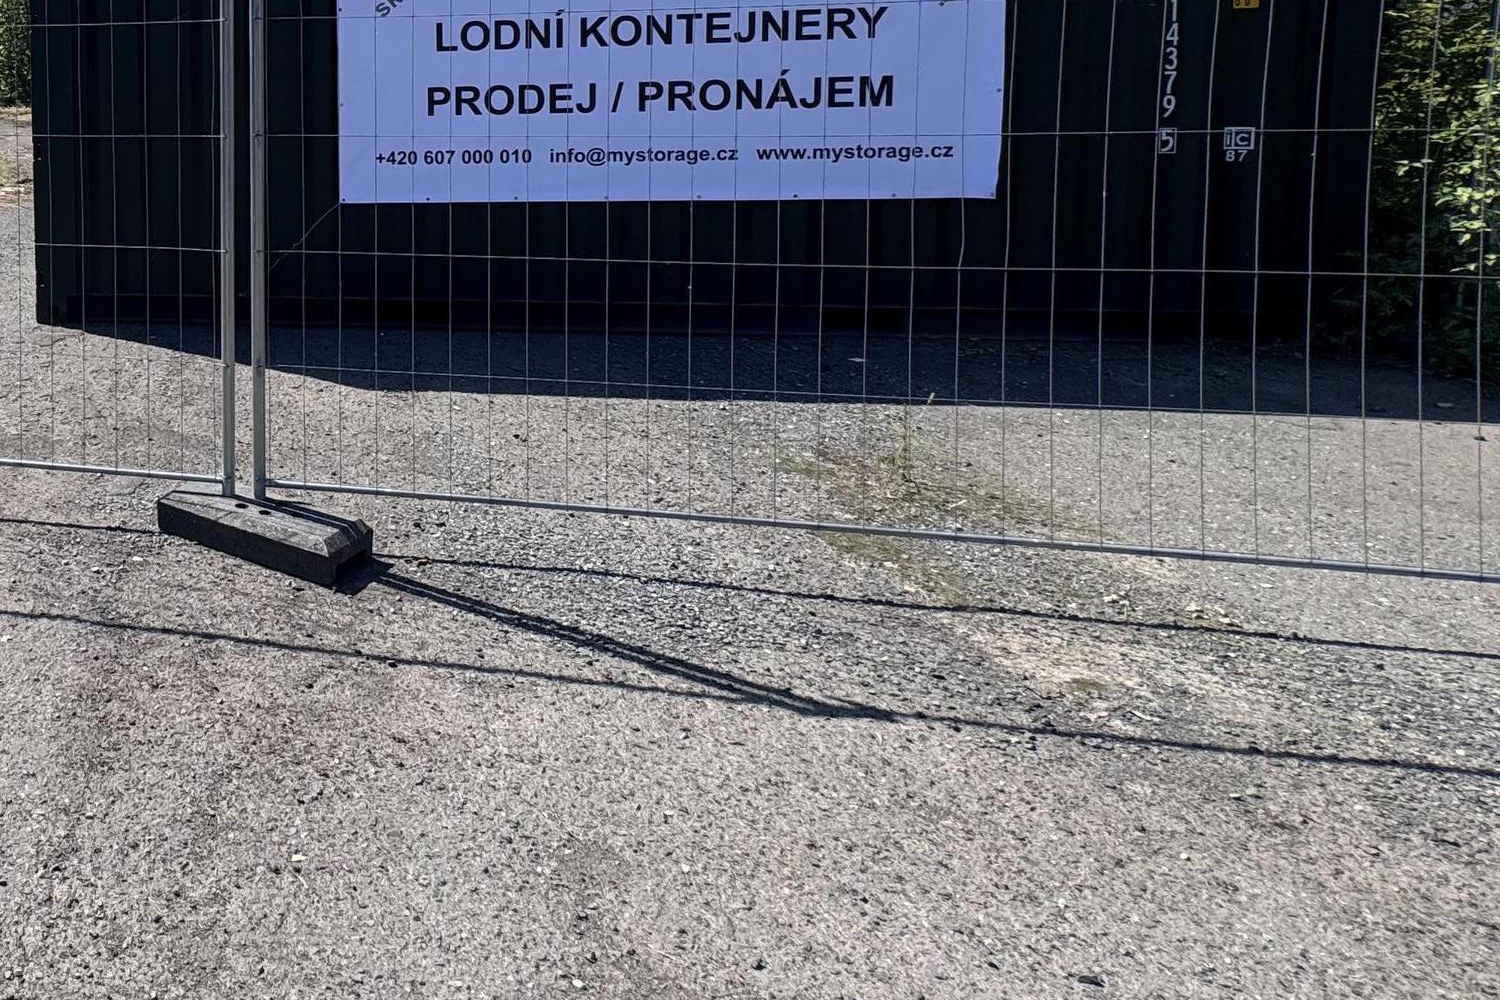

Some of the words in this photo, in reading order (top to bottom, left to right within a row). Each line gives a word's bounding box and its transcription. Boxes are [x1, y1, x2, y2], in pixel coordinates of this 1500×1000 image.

[436, 9, 565, 52] LODNÍ
[580, 6, 889, 48] KONTEJNERY
[427, 82, 597, 117] PRODEJ
[611, 81, 624, 113] /
[638, 69, 894, 112] PRONÁJEM
[1160, 129, 1175, 152] 5
[375, 150, 418, 165] +420
[423, 149, 455, 165] 607
[461, 149, 493, 165] 000
[499, 148, 533, 164] 010
[549, 147, 739, 167] info@mystorage.cz
[756, 143, 954, 163] www.mystorage.cz
[1226, 150, 1247, 162] 87
